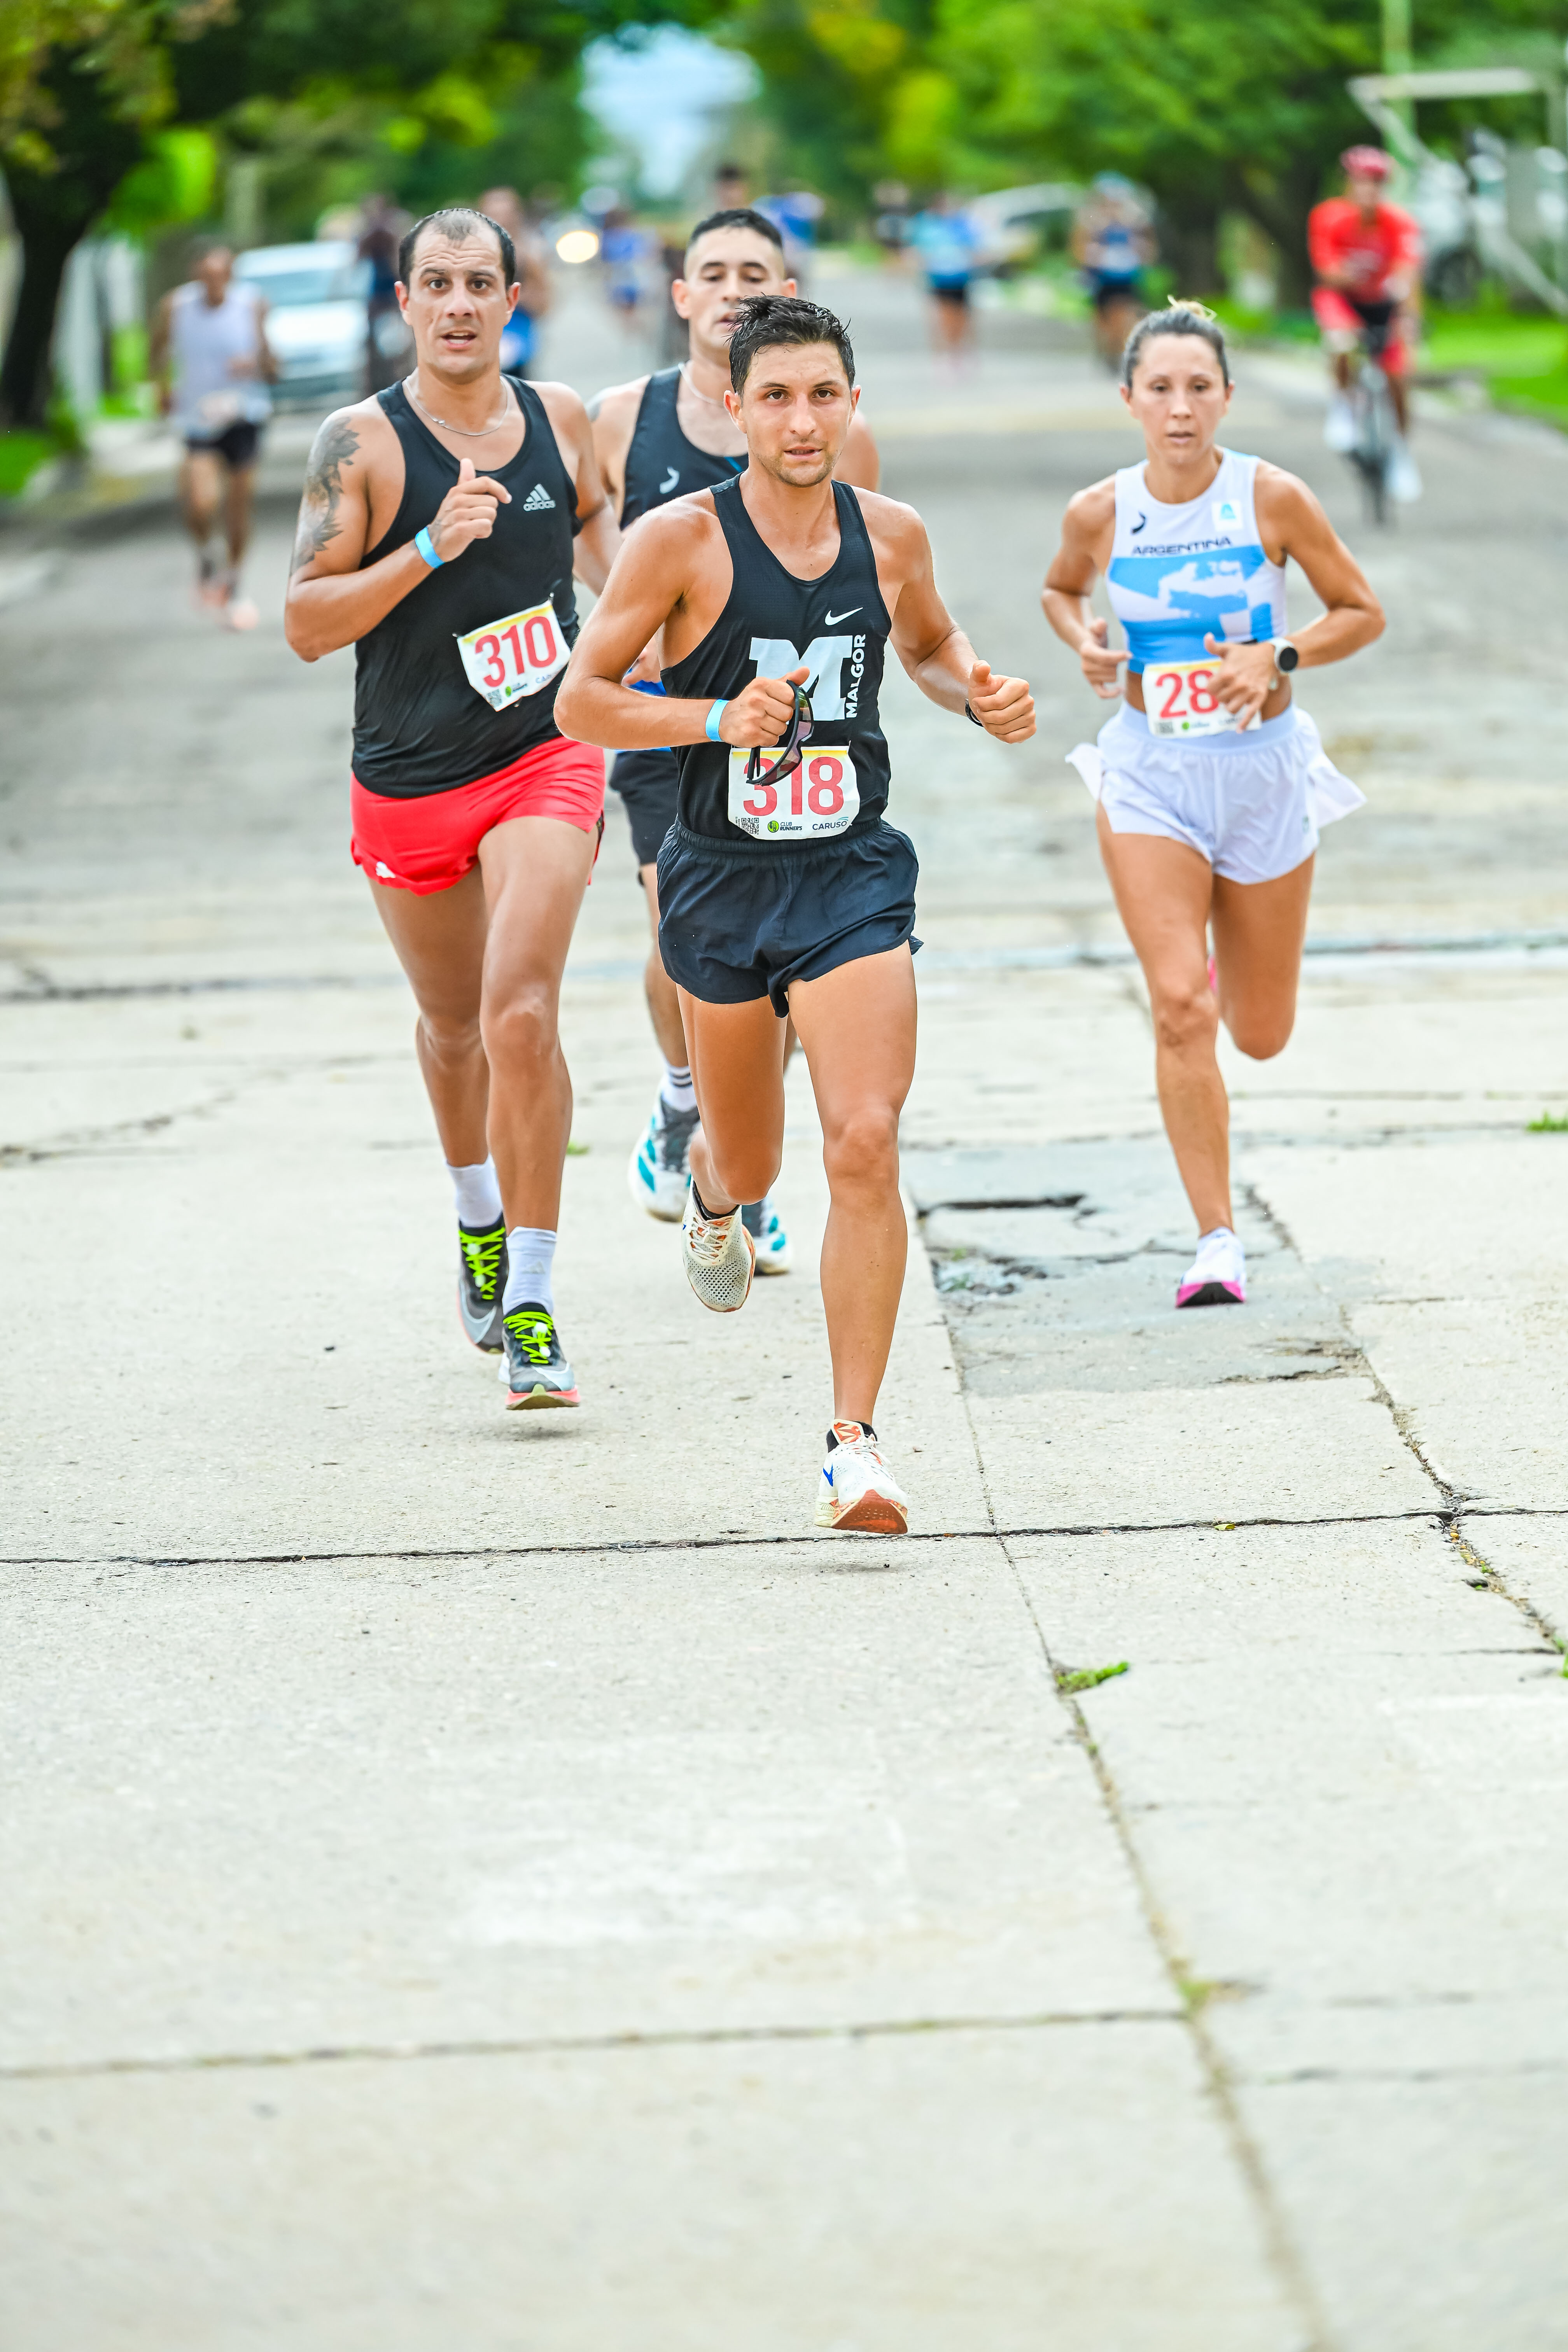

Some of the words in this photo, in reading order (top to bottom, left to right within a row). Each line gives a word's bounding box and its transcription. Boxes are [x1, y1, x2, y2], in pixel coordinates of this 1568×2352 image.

[523, 500, 555, 511] adidas
[1132, 536, 1231, 554] ARGENTINA
[475, 616, 557, 687] 310
[846, 634, 866, 718] MALGOR
[1155, 670, 1220, 718] 28
[743, 756, 844, 816] 318
[812, 821, 847, 830] CARUSO
